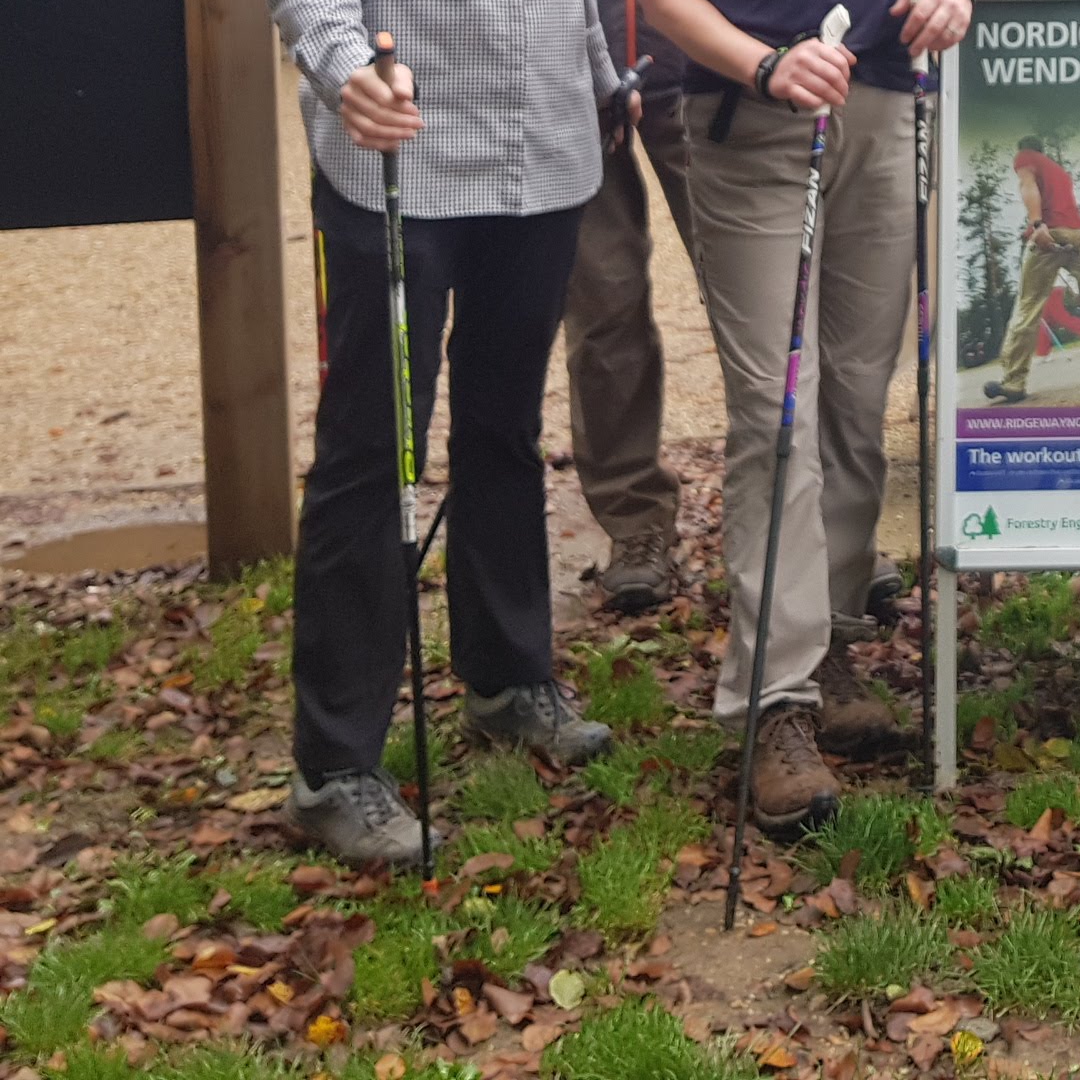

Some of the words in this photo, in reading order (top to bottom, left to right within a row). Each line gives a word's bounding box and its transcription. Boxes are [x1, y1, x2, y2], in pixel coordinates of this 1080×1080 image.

[802, 167, 820, 254] FIZAN
[968, 447, 1002, 465] The
[1007, 517, 1057, 532] Forestry
